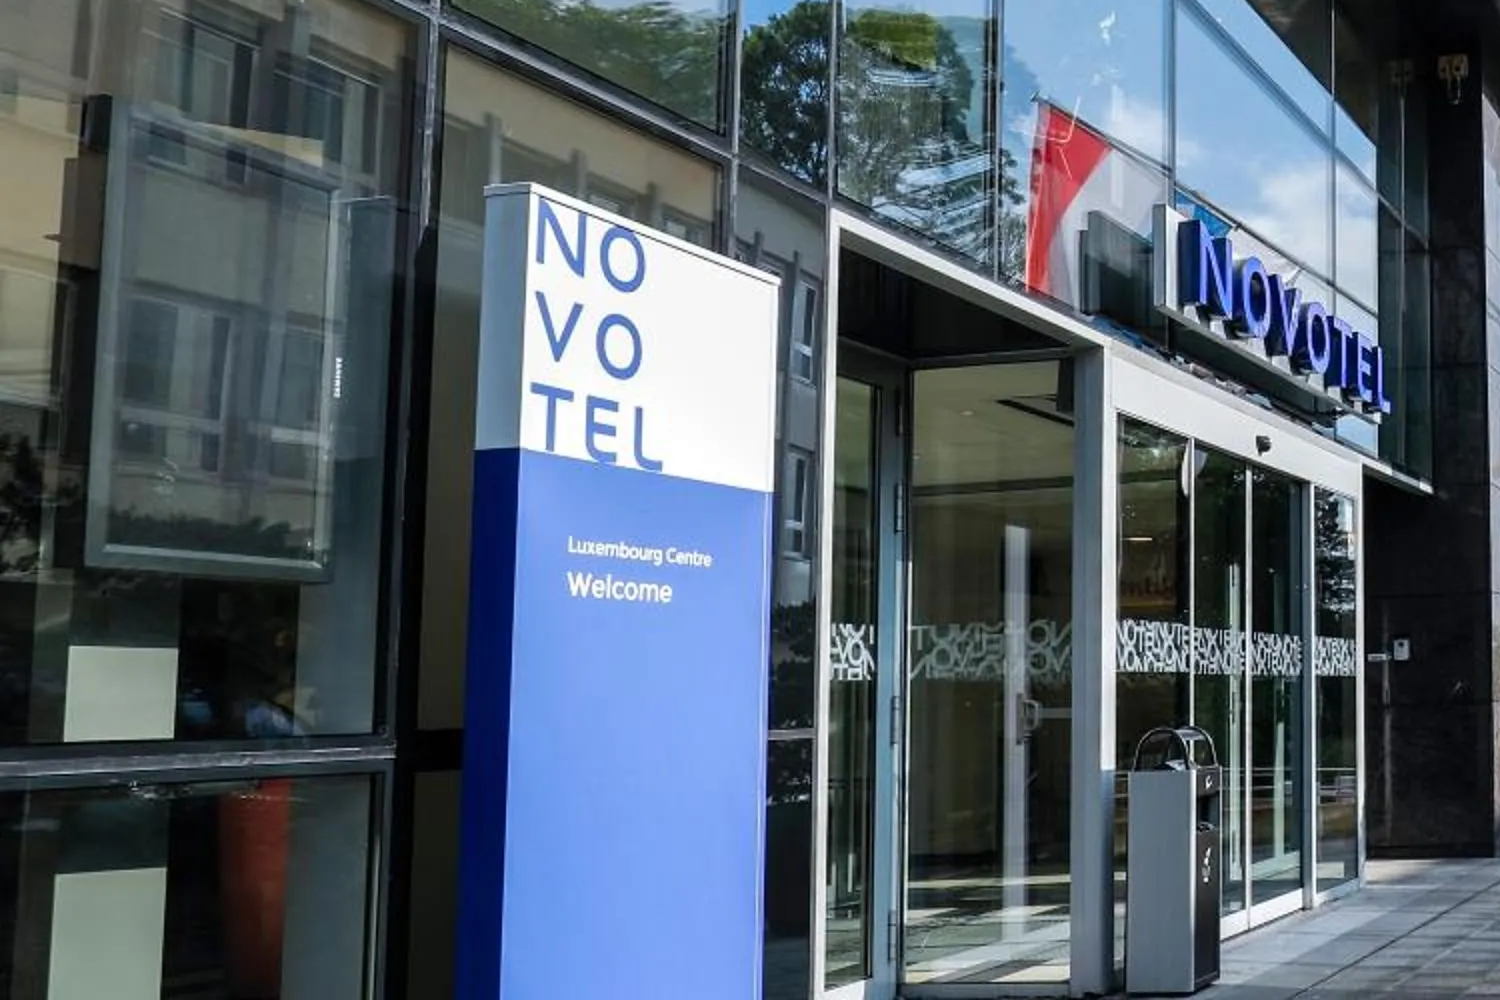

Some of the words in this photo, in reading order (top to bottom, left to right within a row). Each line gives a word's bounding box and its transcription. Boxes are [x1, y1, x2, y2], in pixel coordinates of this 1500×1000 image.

[535, 199, 646, 293] NO
[535, 291, 643, 381] VO
[1180, 219, 1391, 415] NOVOTEL
[530, 382, 663, 472] TEL
[567, 535, 663, 566] Luxembourg
[665, 547, 713, 567] Centre
[567, 571, 673, 604] Welcome
